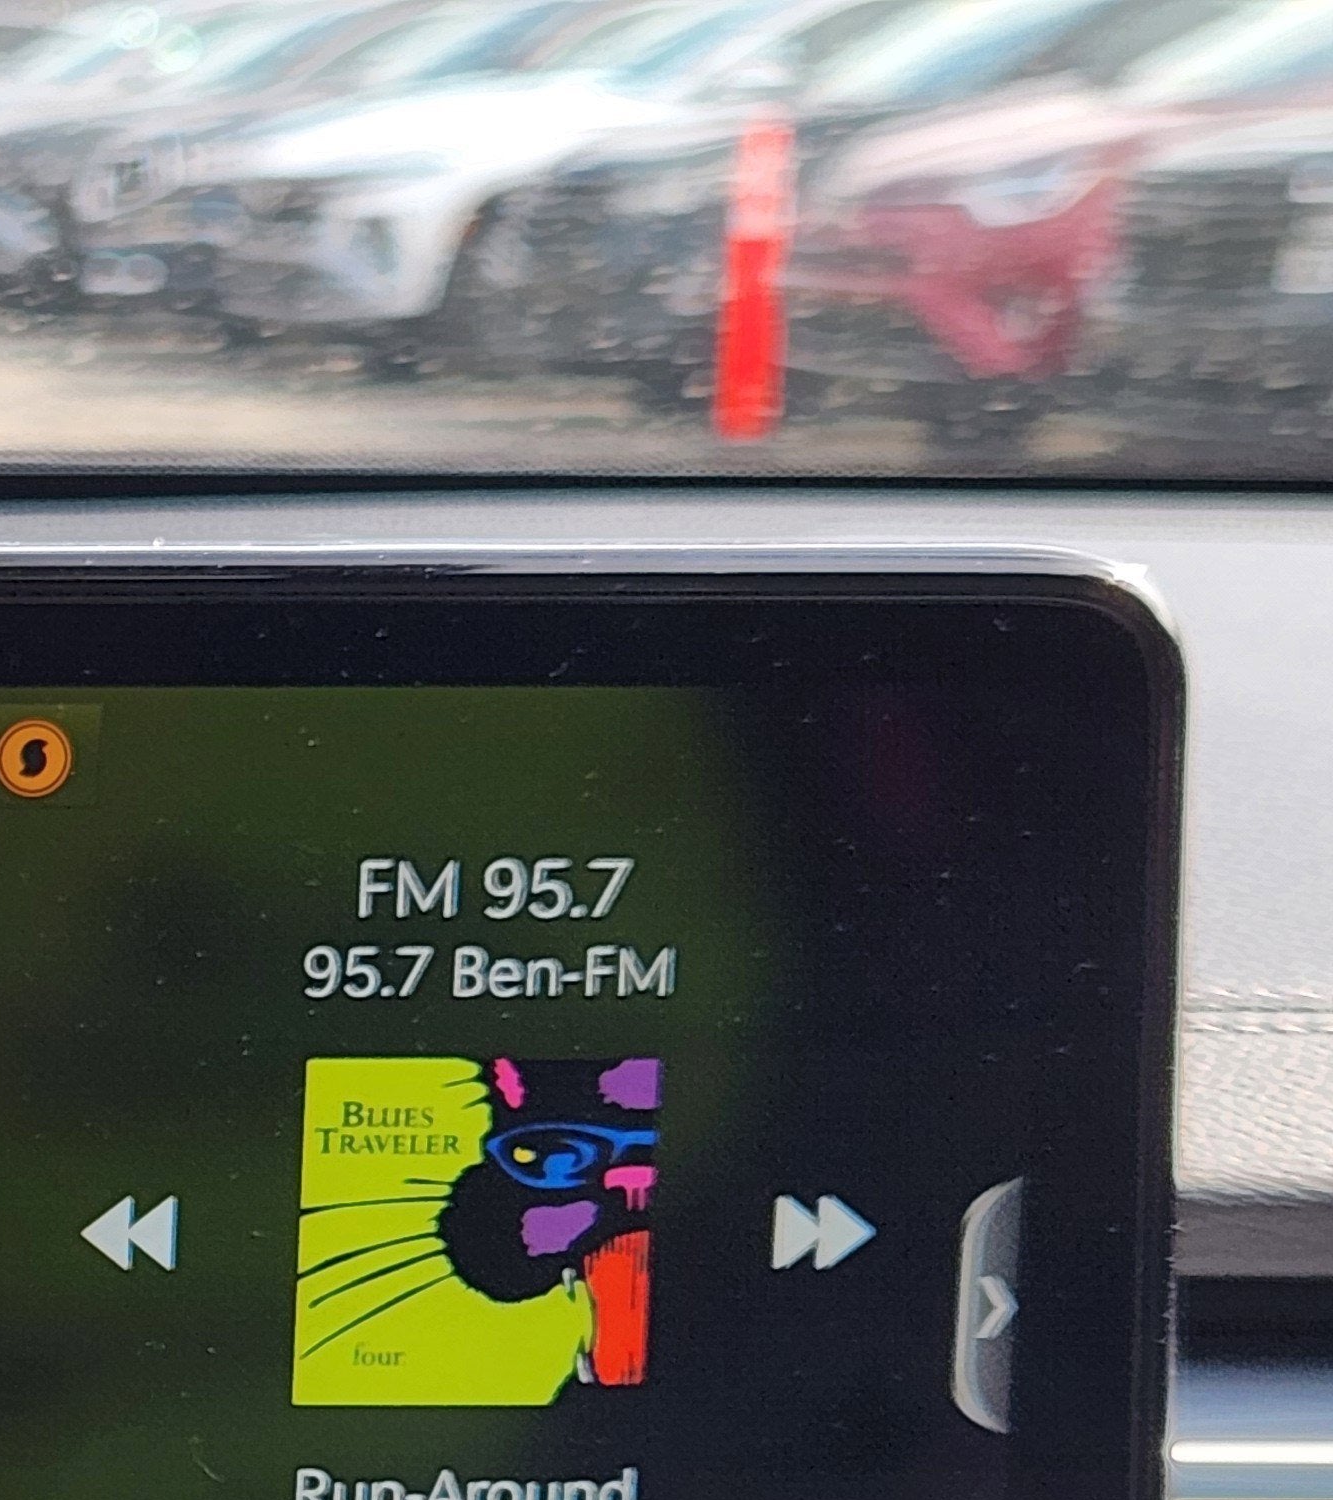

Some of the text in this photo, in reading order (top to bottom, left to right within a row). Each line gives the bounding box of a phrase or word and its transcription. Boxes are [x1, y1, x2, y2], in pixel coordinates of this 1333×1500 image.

[355, 857, 635, 921] FM 95.7
[302, 944, 678, 999] 95.7 Ben-FM
[341, 1100, 435, 1128] BLUES
[314, 1127, 461, 1155] TRAVELER
[353, 1342, 406, 1367] four
